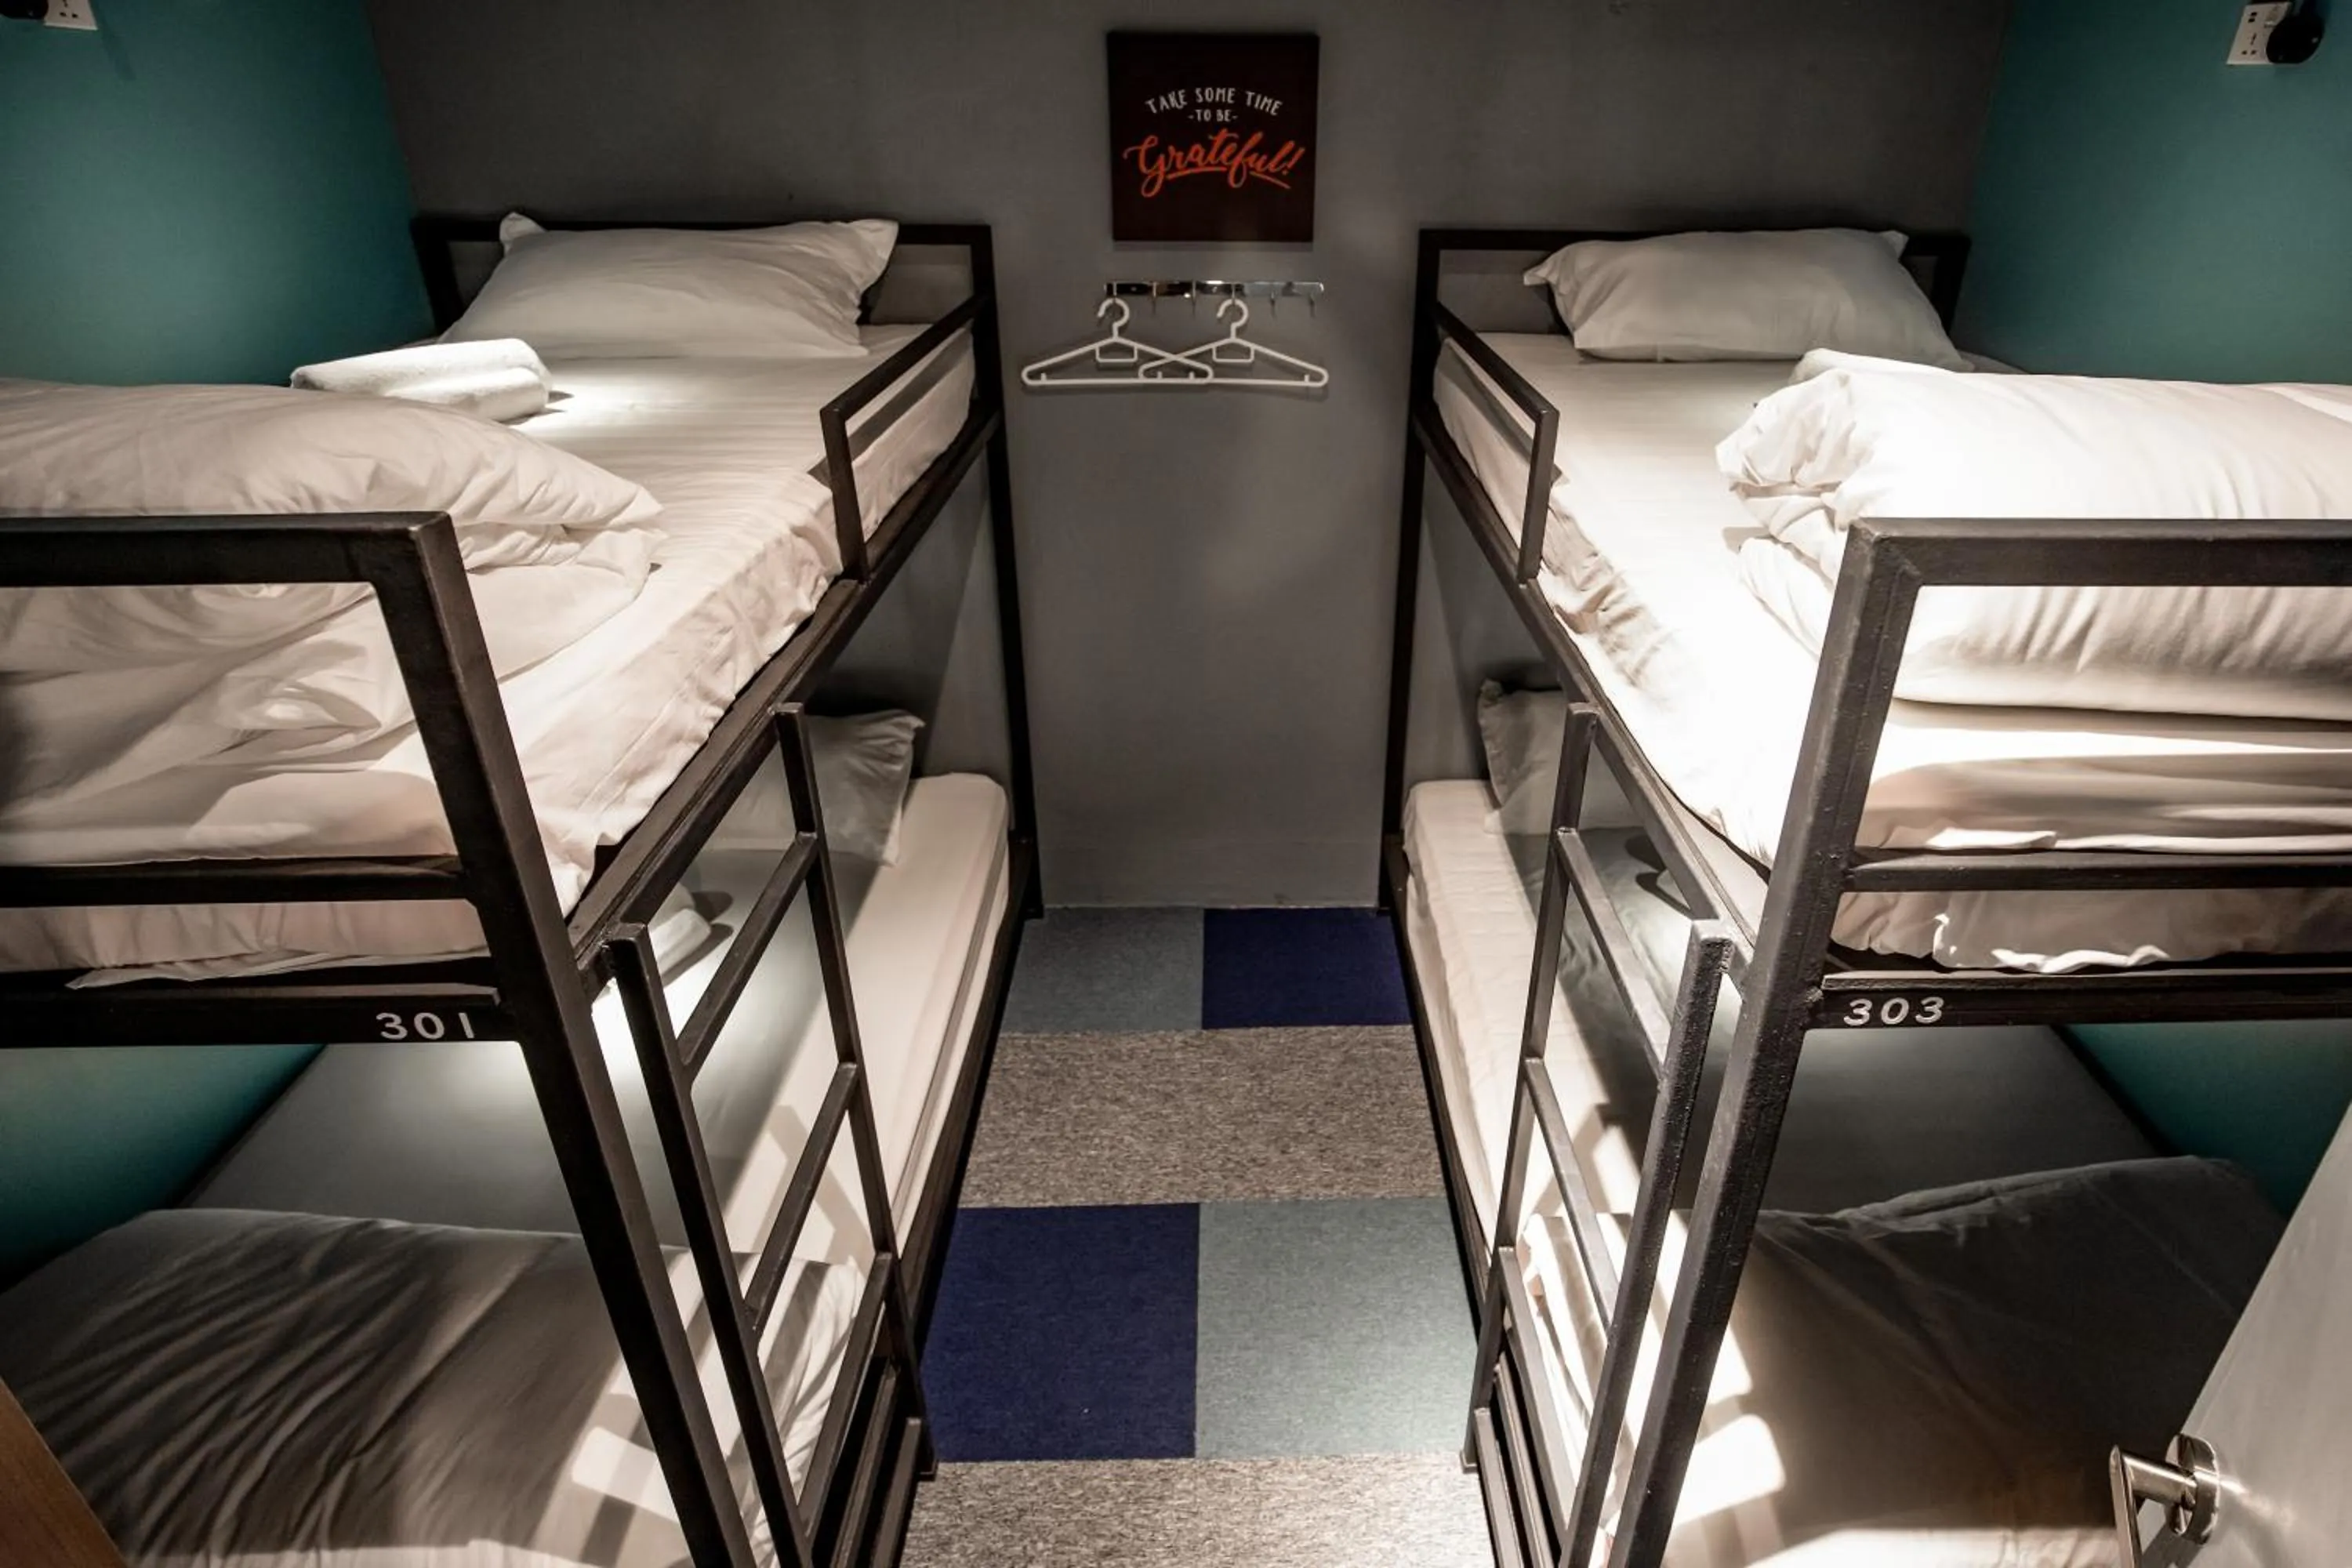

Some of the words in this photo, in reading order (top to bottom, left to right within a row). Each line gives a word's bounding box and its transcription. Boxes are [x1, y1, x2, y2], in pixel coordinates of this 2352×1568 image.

[1145, 89, 1188, 114] TAKE
[1195, 87, 1236, 103] SOME
[1245, 90, 1283, 116] TIME
[1123, 129, 1305, 198] Grateful!
[1843, 996, 1944, 1025] 303
[376, 1012, 475, 1040] 301
